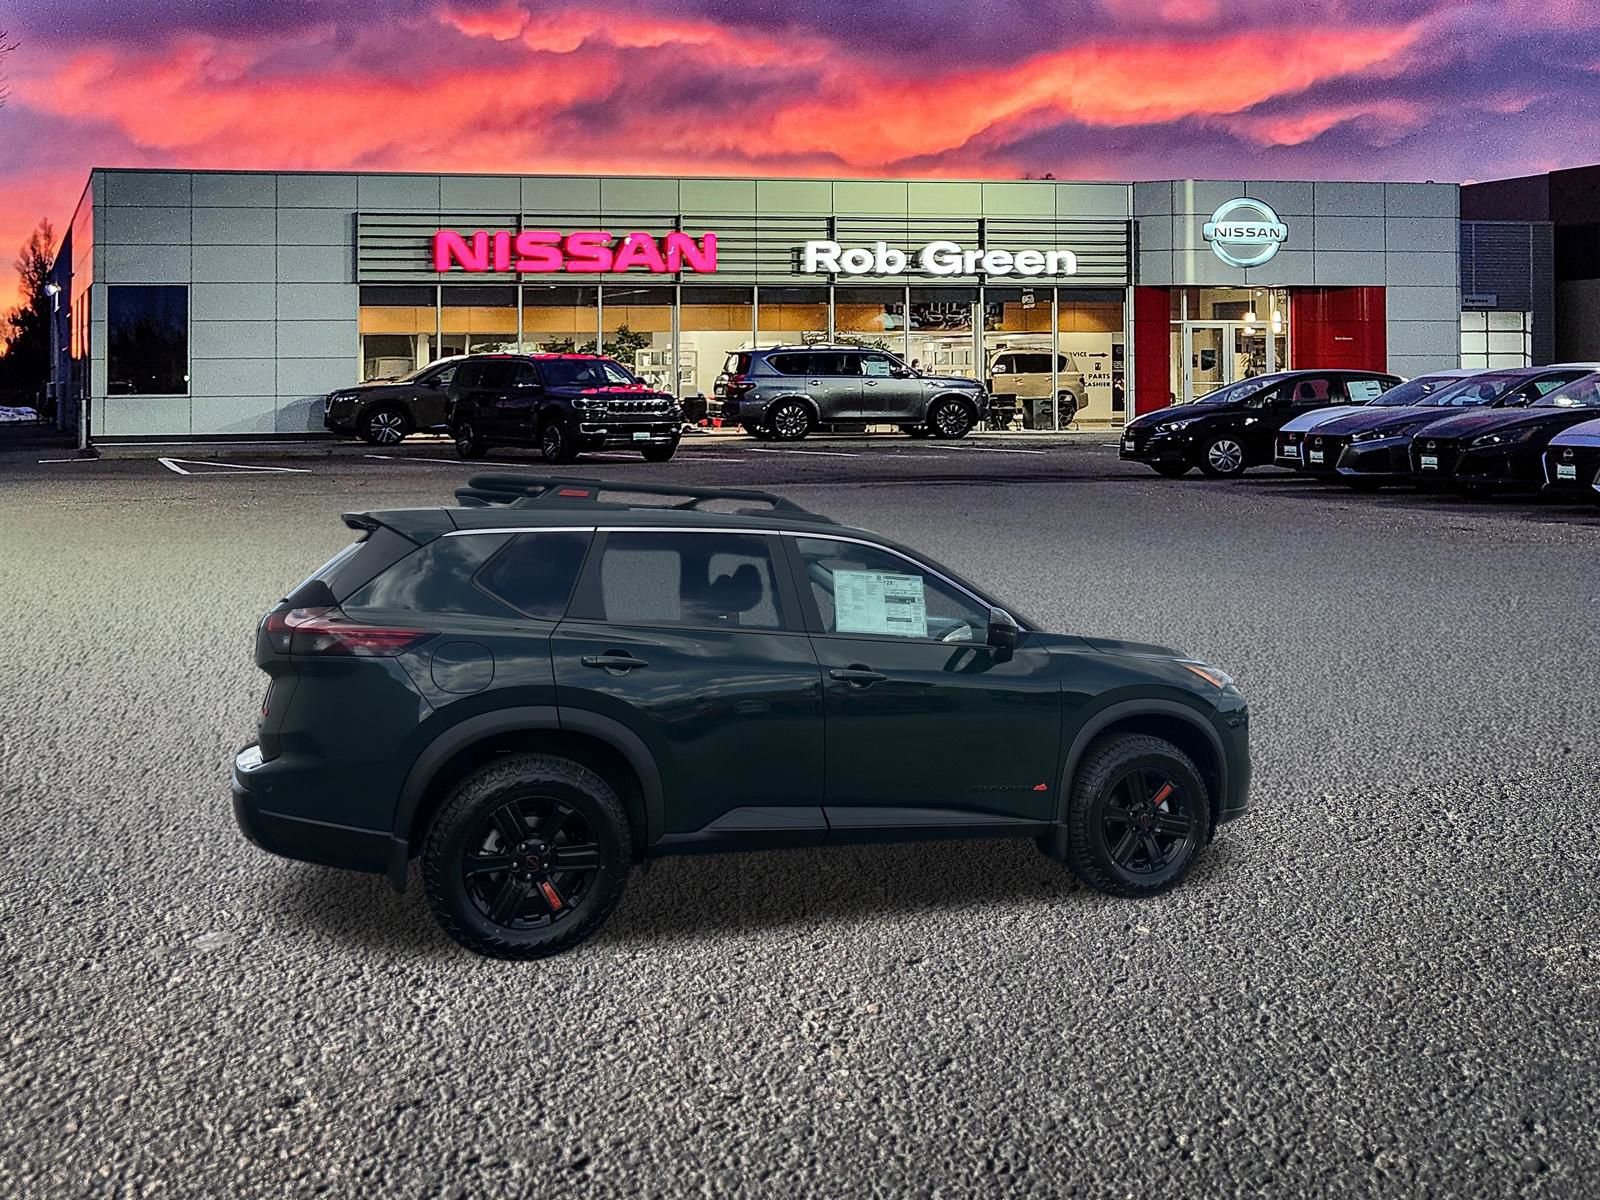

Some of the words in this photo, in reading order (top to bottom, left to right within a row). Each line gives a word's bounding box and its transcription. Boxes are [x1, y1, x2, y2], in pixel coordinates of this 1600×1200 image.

[1214, 227, 1280, 238] NISSAN
[433, 230, 717, 273] NISSAN
[804, 240, 907, 274] Rob
[922, 241, 1078, 275] Green
